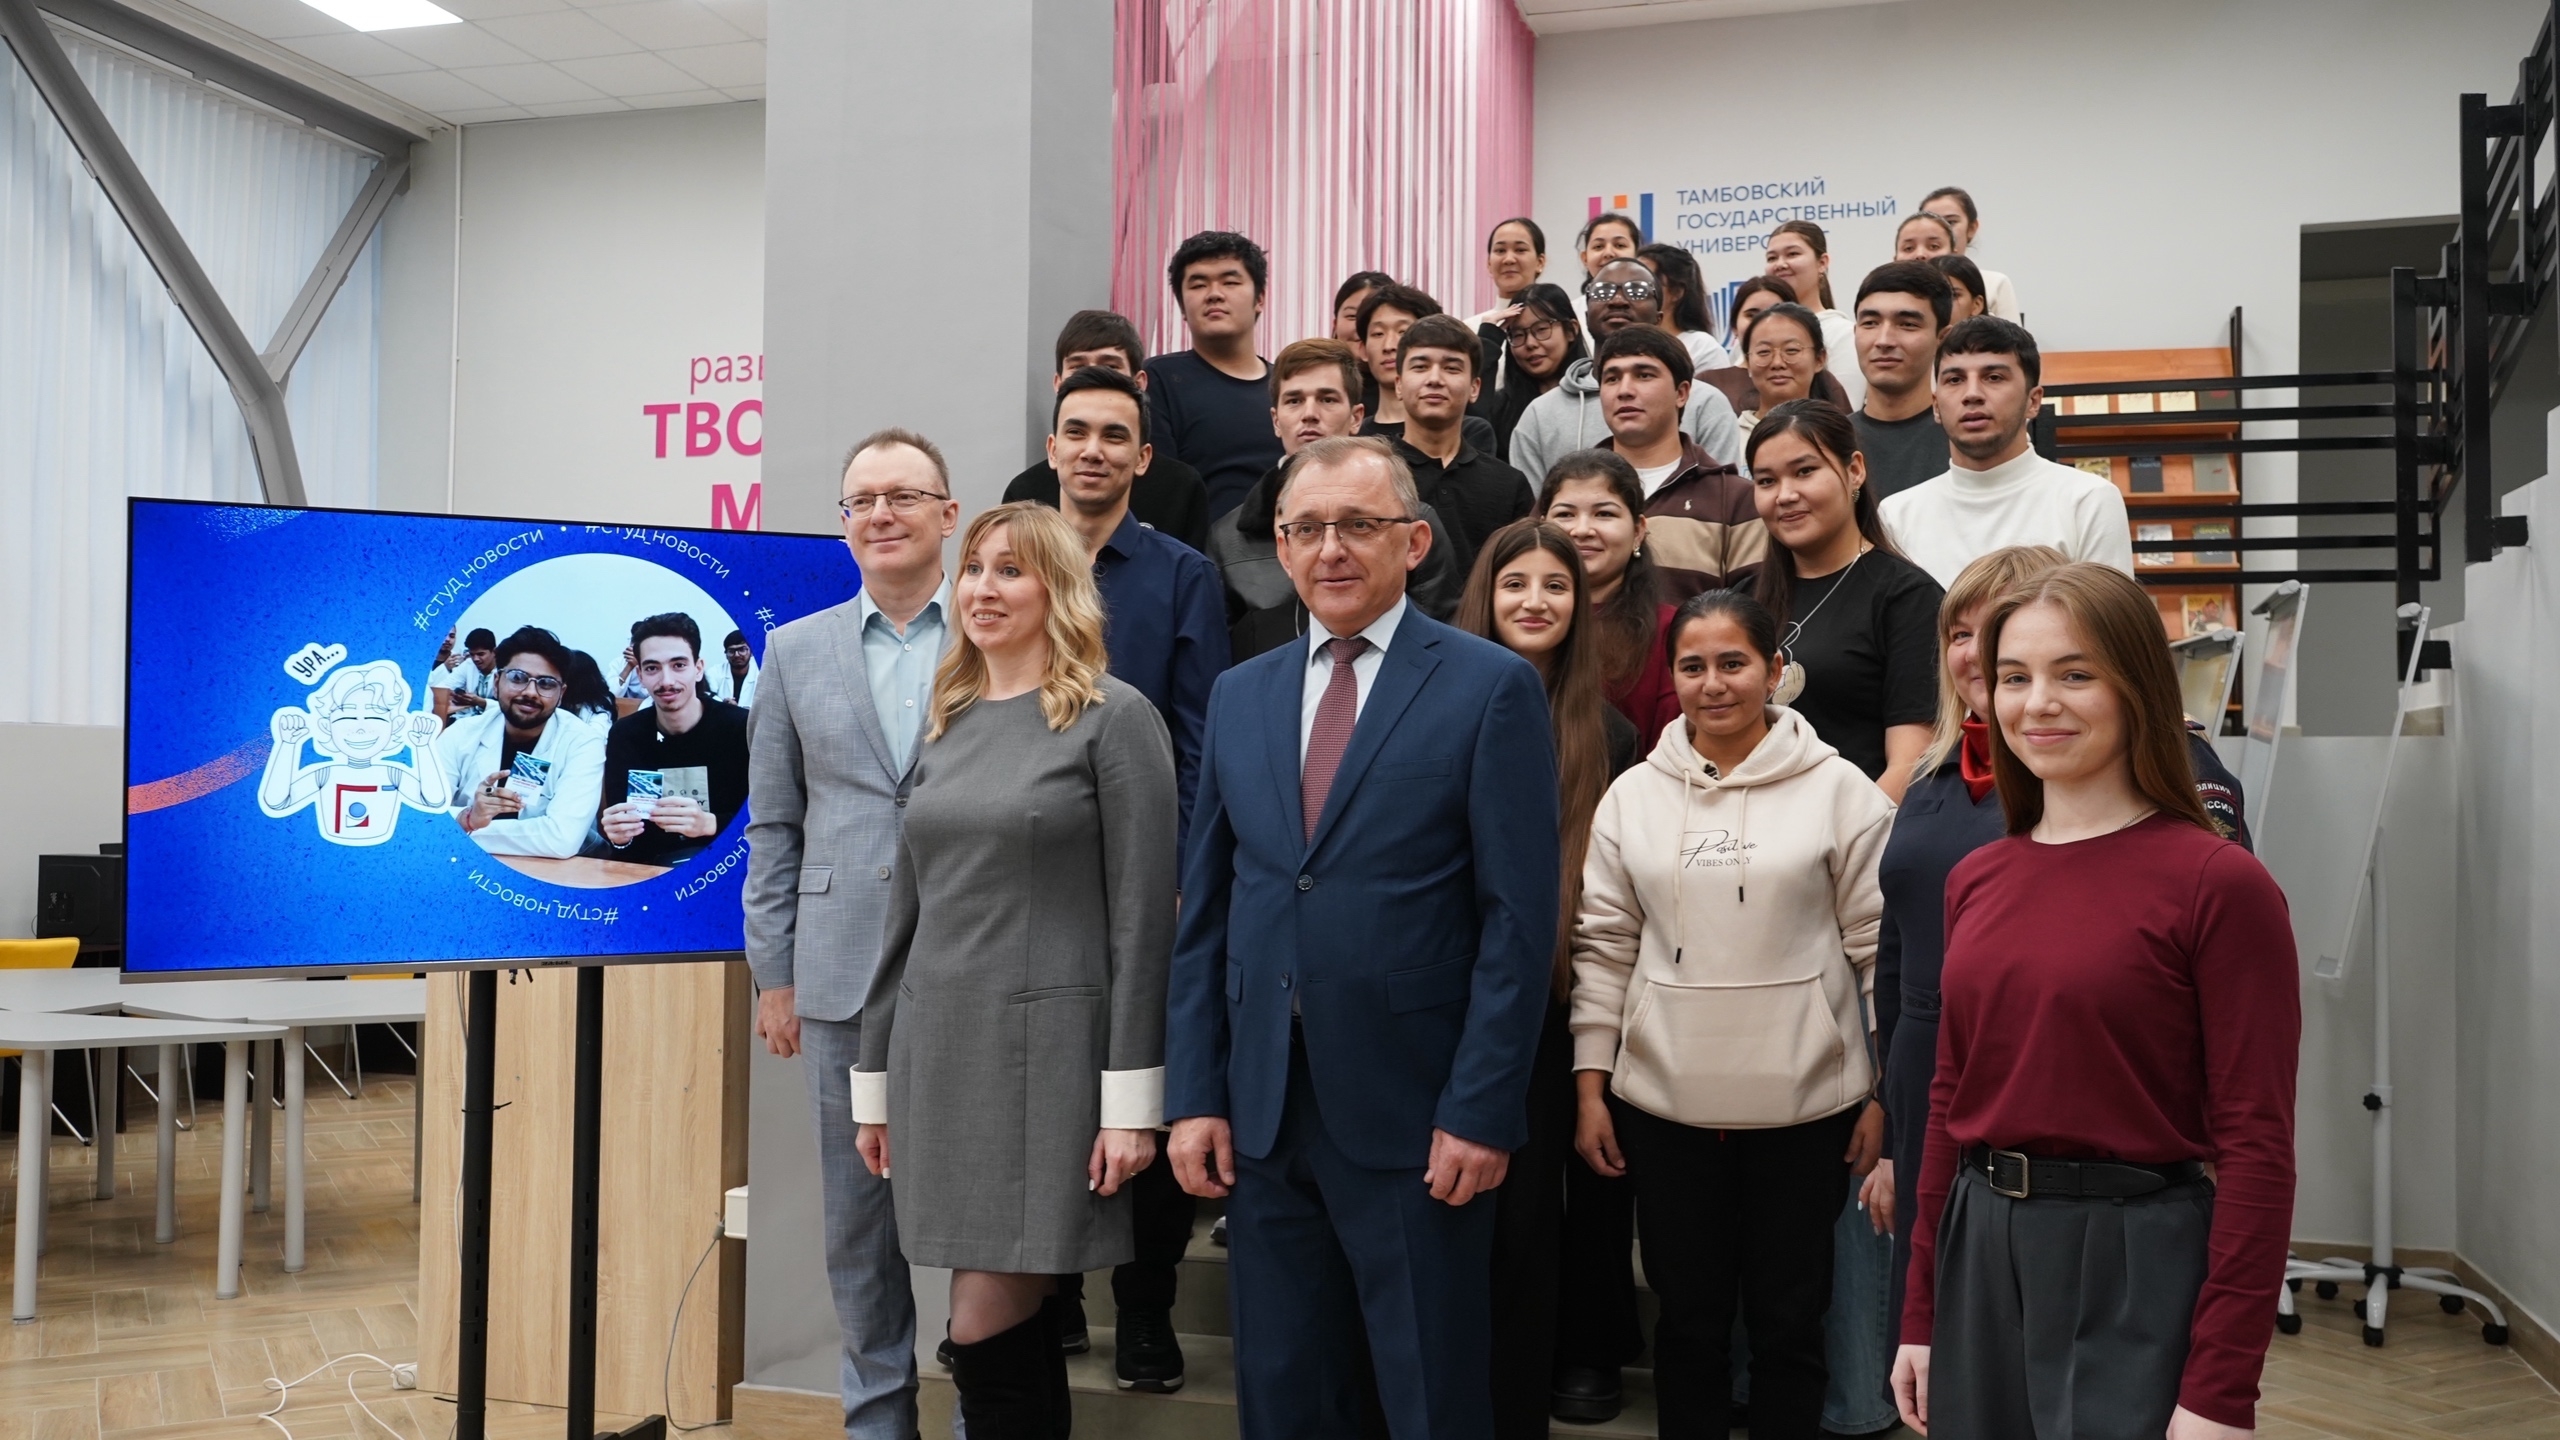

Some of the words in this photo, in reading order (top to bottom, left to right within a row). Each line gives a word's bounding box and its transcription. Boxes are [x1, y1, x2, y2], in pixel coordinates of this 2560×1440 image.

[1676, 176, 1826, 206] ТАМБОВСКИЙ
[1677, 195, 1897, 230] ГОСУДАРСТВЕННЫЙ
[690, 354, 763, 395] раз
[2195, 782, 2232, 796] ОЛИЦИЯ
[1696, 859, 1723, 867] VIBES
[1725, 856, 1752, 867] ONY
